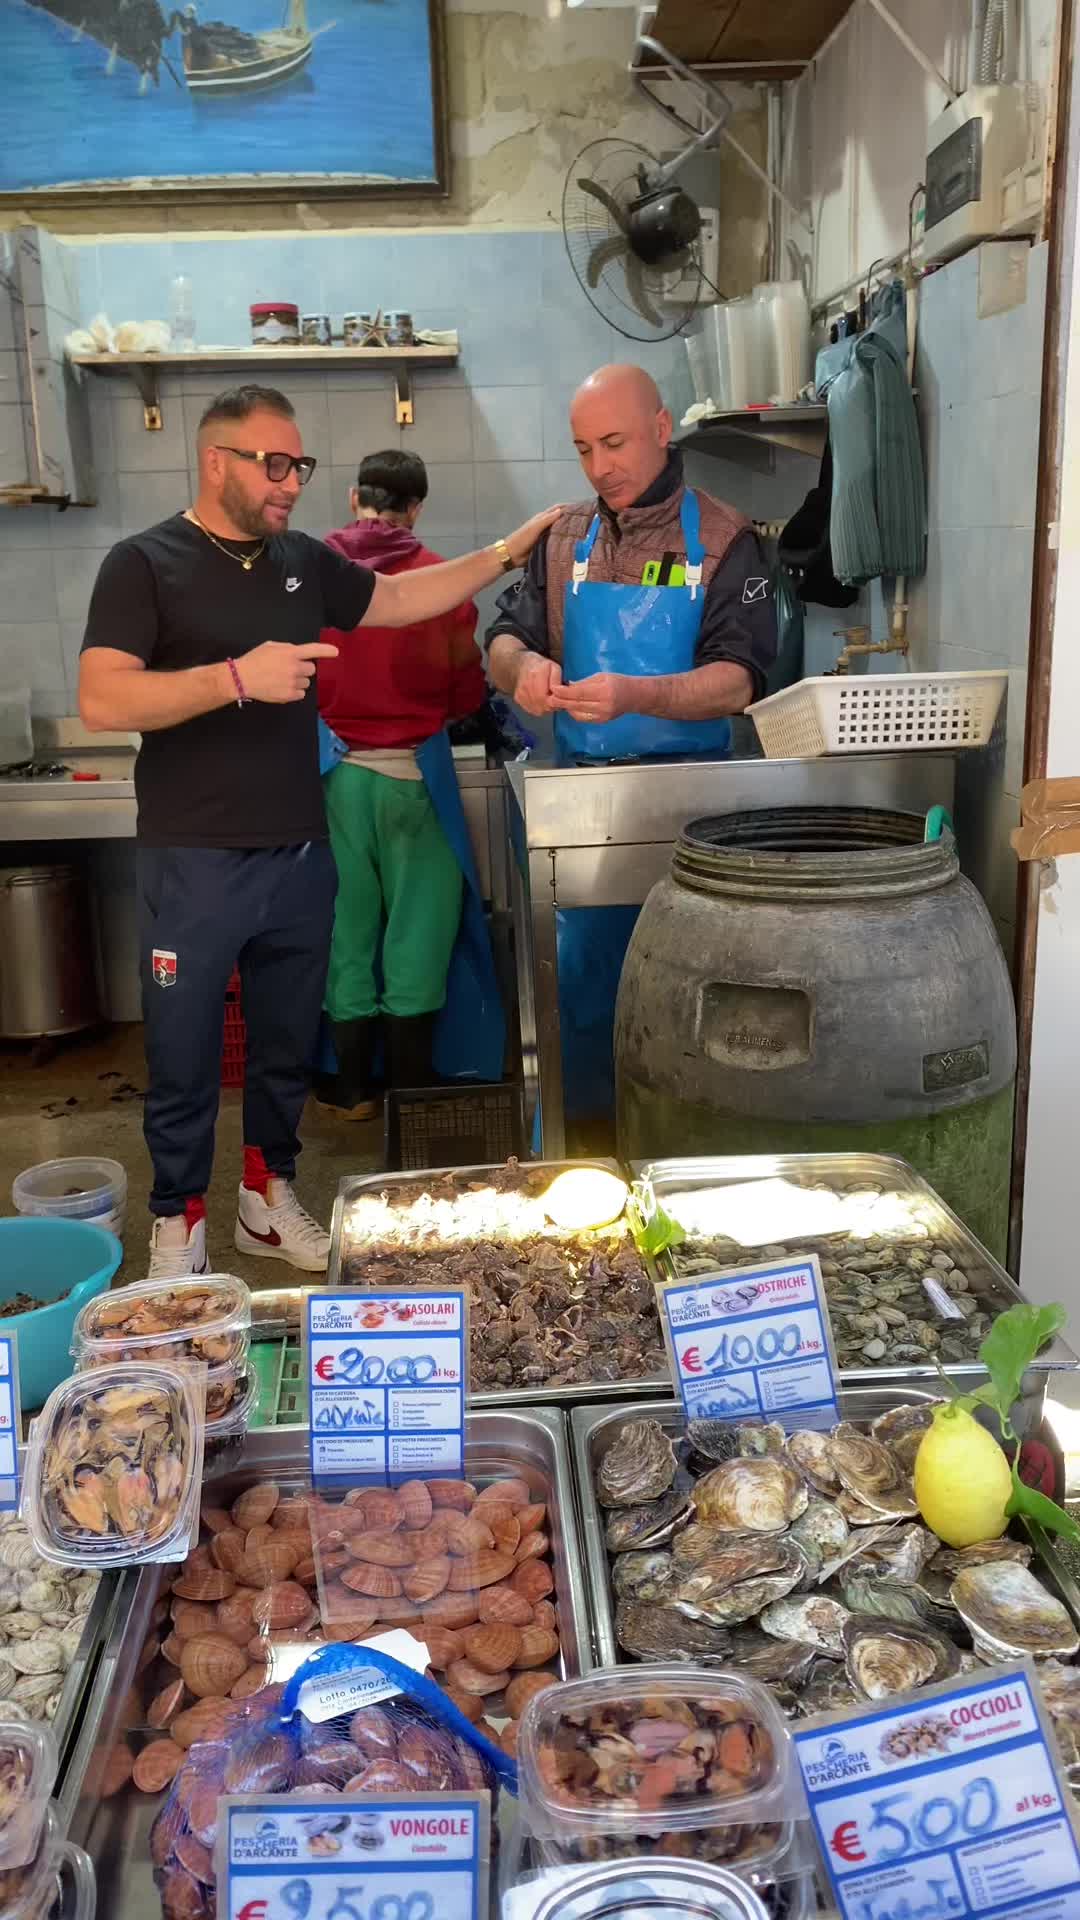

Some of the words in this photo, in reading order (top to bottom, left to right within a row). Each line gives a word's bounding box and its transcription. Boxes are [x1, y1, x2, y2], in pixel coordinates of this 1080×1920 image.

[757, 1275, 808, 1294] OSTRICHE
[405, 1303, 455, 1316] FASOLARI
[671, 1303, 710, 1316] PESCHERIA
[672, 1310, 711, 1323] D'ARCANTE
[312, 1314, 353, 1324] PESCHERIA
[681, 1346, 702, 1373] €
[806, 1339, 822, 1351] kg.
[443, 1368, 459, 1380] kg.
[319, 1691, 346, 1704] Lotto
[949, 1692, 1024, 1727] COCCIOLI
[804, 1751, 867, 1775] PESCHERIA
[808, 1762, 872, 1786] D'ARCANTE
[389, 1817, 470, 1837] VONGOLE
[829, 1820, 867, 1862] €
[1015, 1797, 1031, 1813] al
[1033, 1791, 1057, 1809] kg.
[233, 1836, 299, 1851] PESCHERIA
[233, 1848, 299, 1858] D'ARCANTE
